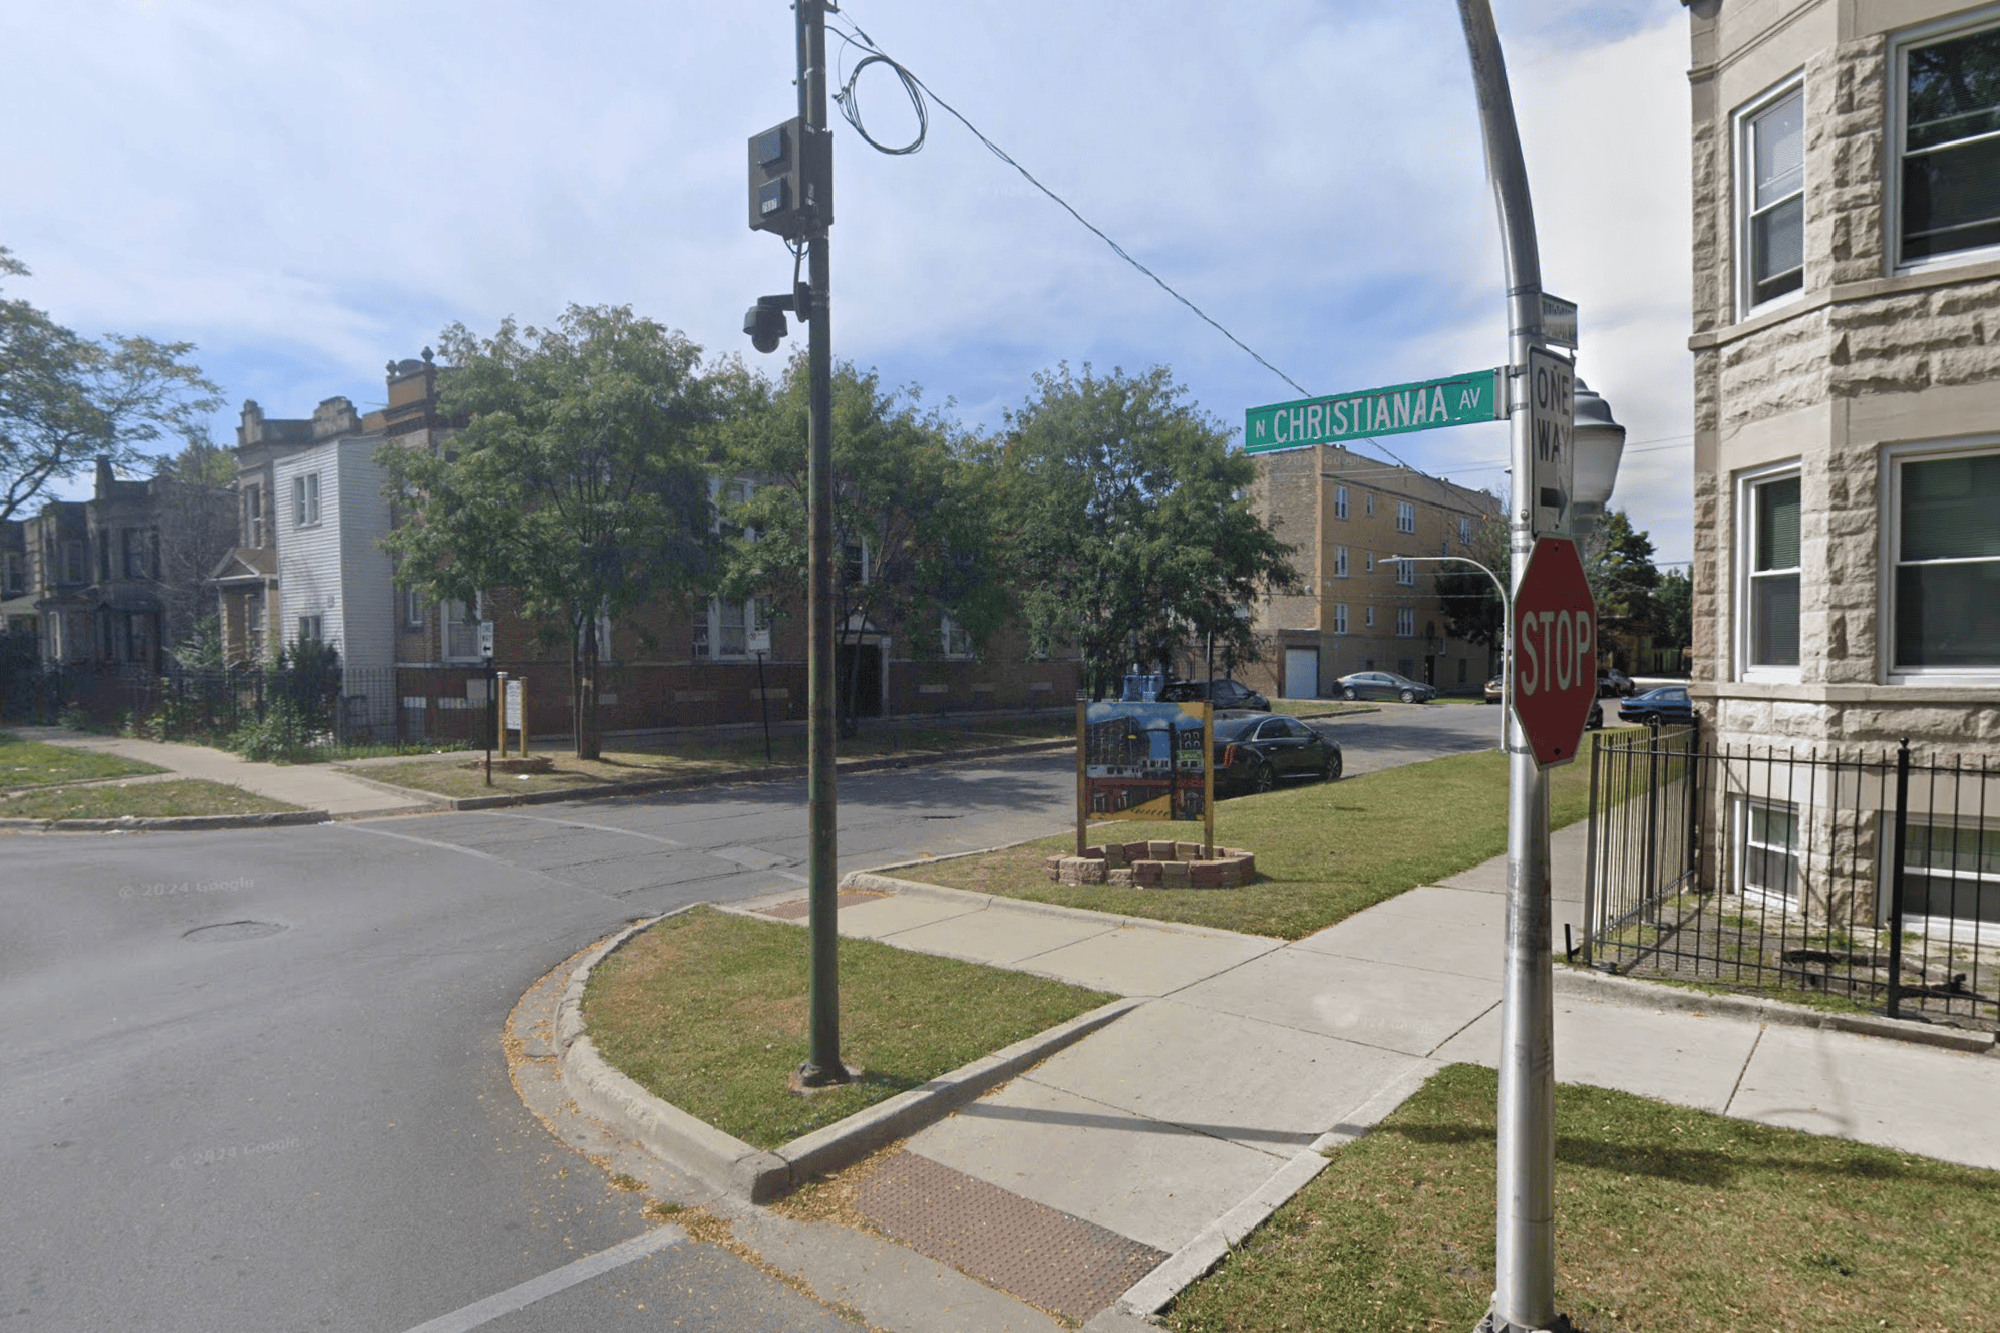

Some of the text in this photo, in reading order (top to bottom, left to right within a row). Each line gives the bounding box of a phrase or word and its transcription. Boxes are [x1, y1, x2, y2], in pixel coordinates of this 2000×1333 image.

[1255, 419, 1265, 438] N
[1459, 387, 1481, 410] AV
[1538, 367, 1569, 416] ONE
[1538, 418, 1570, 464] WAY
[1520, 609, 1591, 696] STOP
